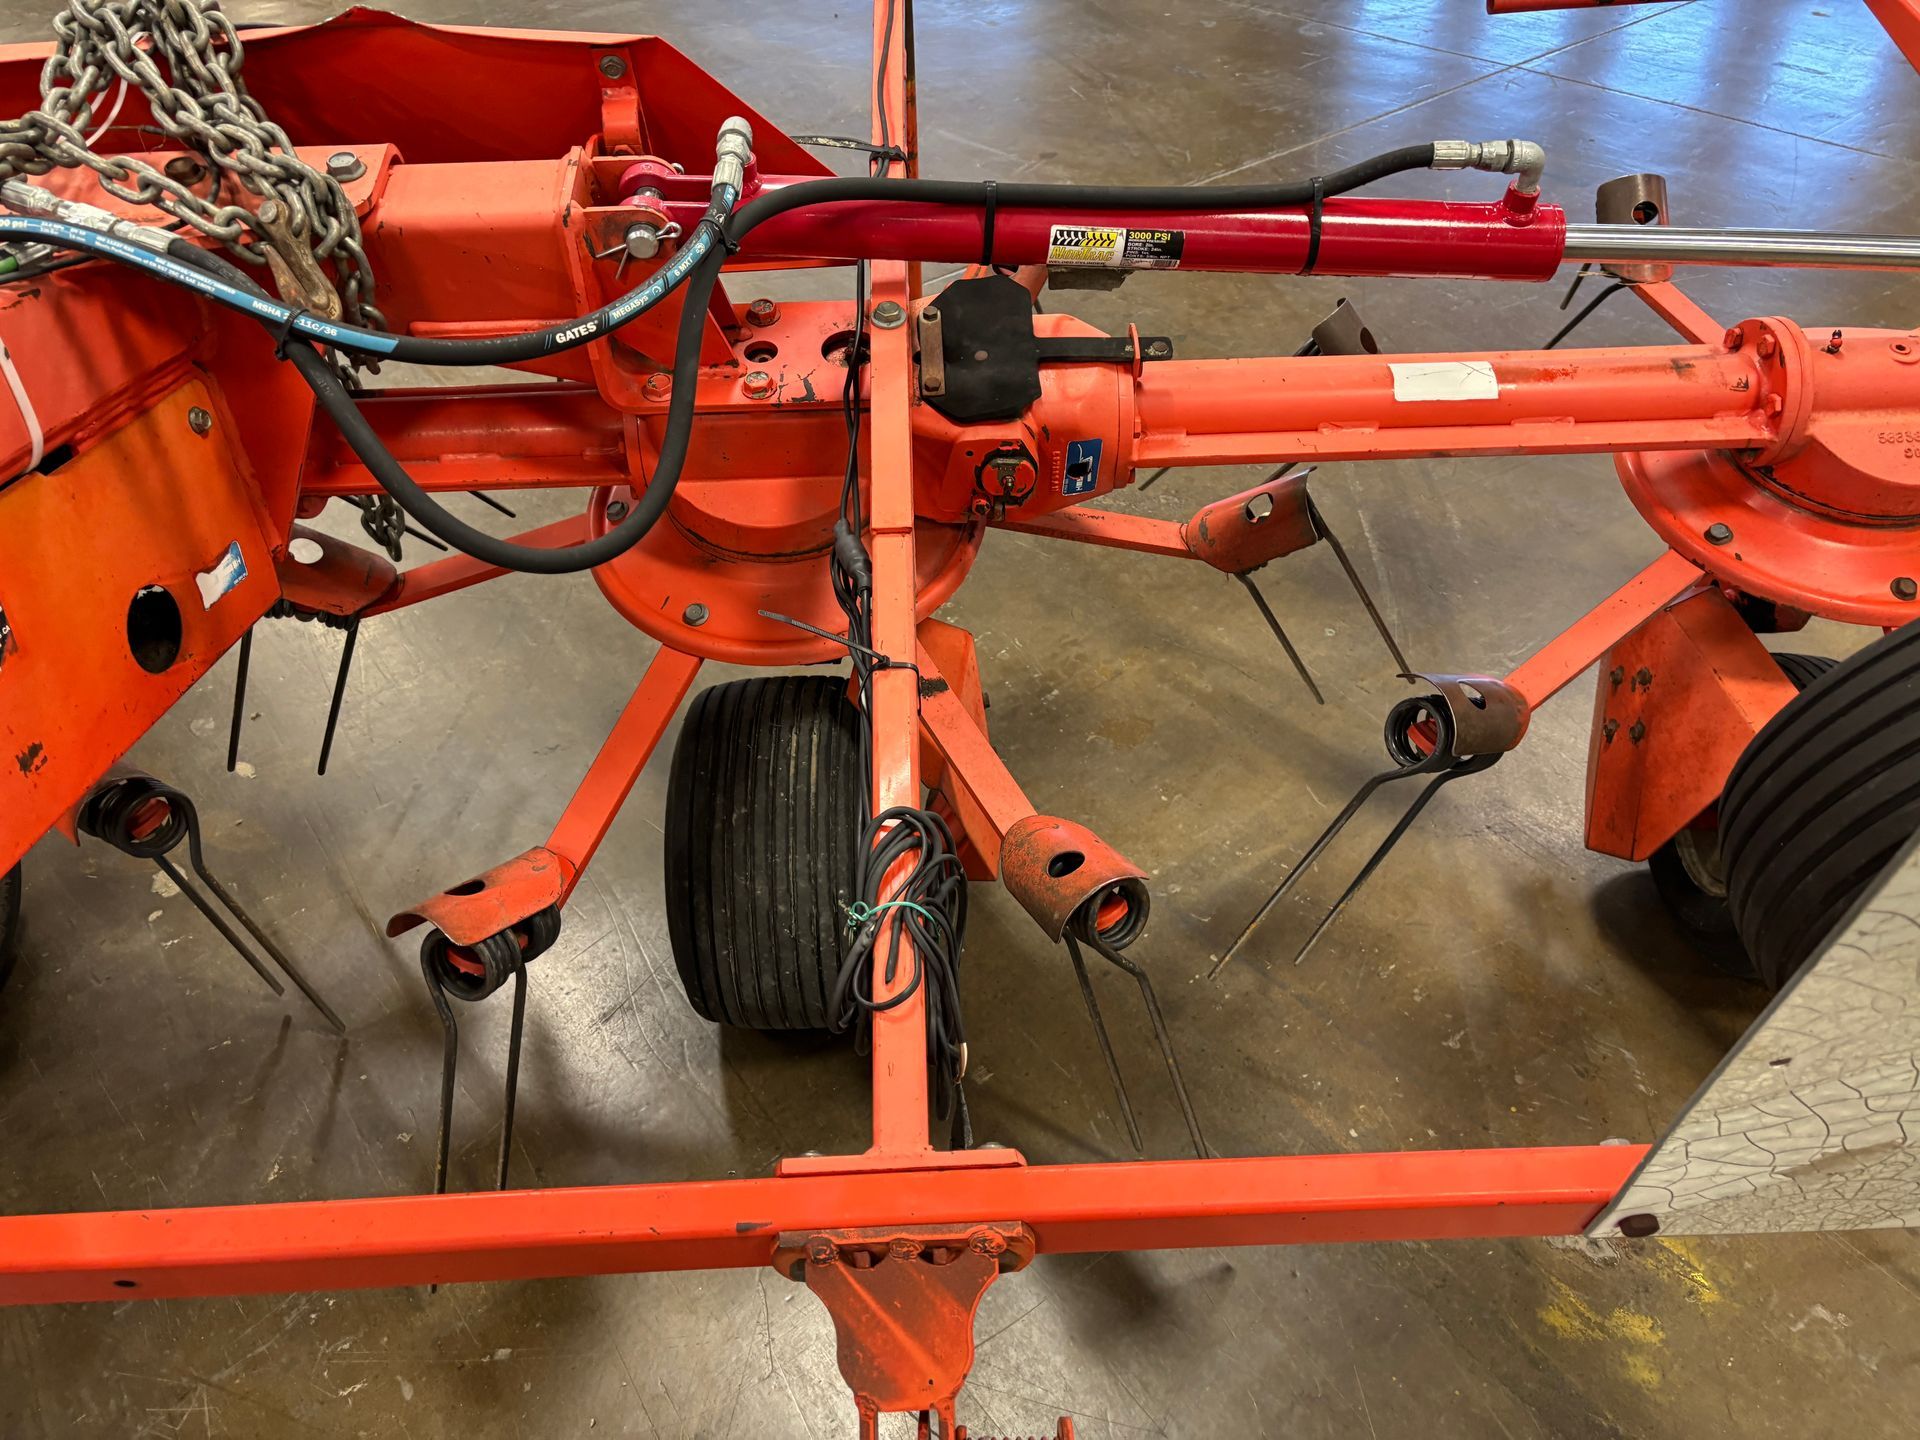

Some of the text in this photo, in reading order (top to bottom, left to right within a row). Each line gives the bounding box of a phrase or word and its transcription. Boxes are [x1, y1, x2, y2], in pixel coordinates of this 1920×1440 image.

[1129, 231, 1171, 241] 3000 PSI
[555, 255, 694, 344] GATES MEGASys 6 MXT
[252, 300, 282, 319] MSHA
[283, 312, 338, 336] 2-11C/36
